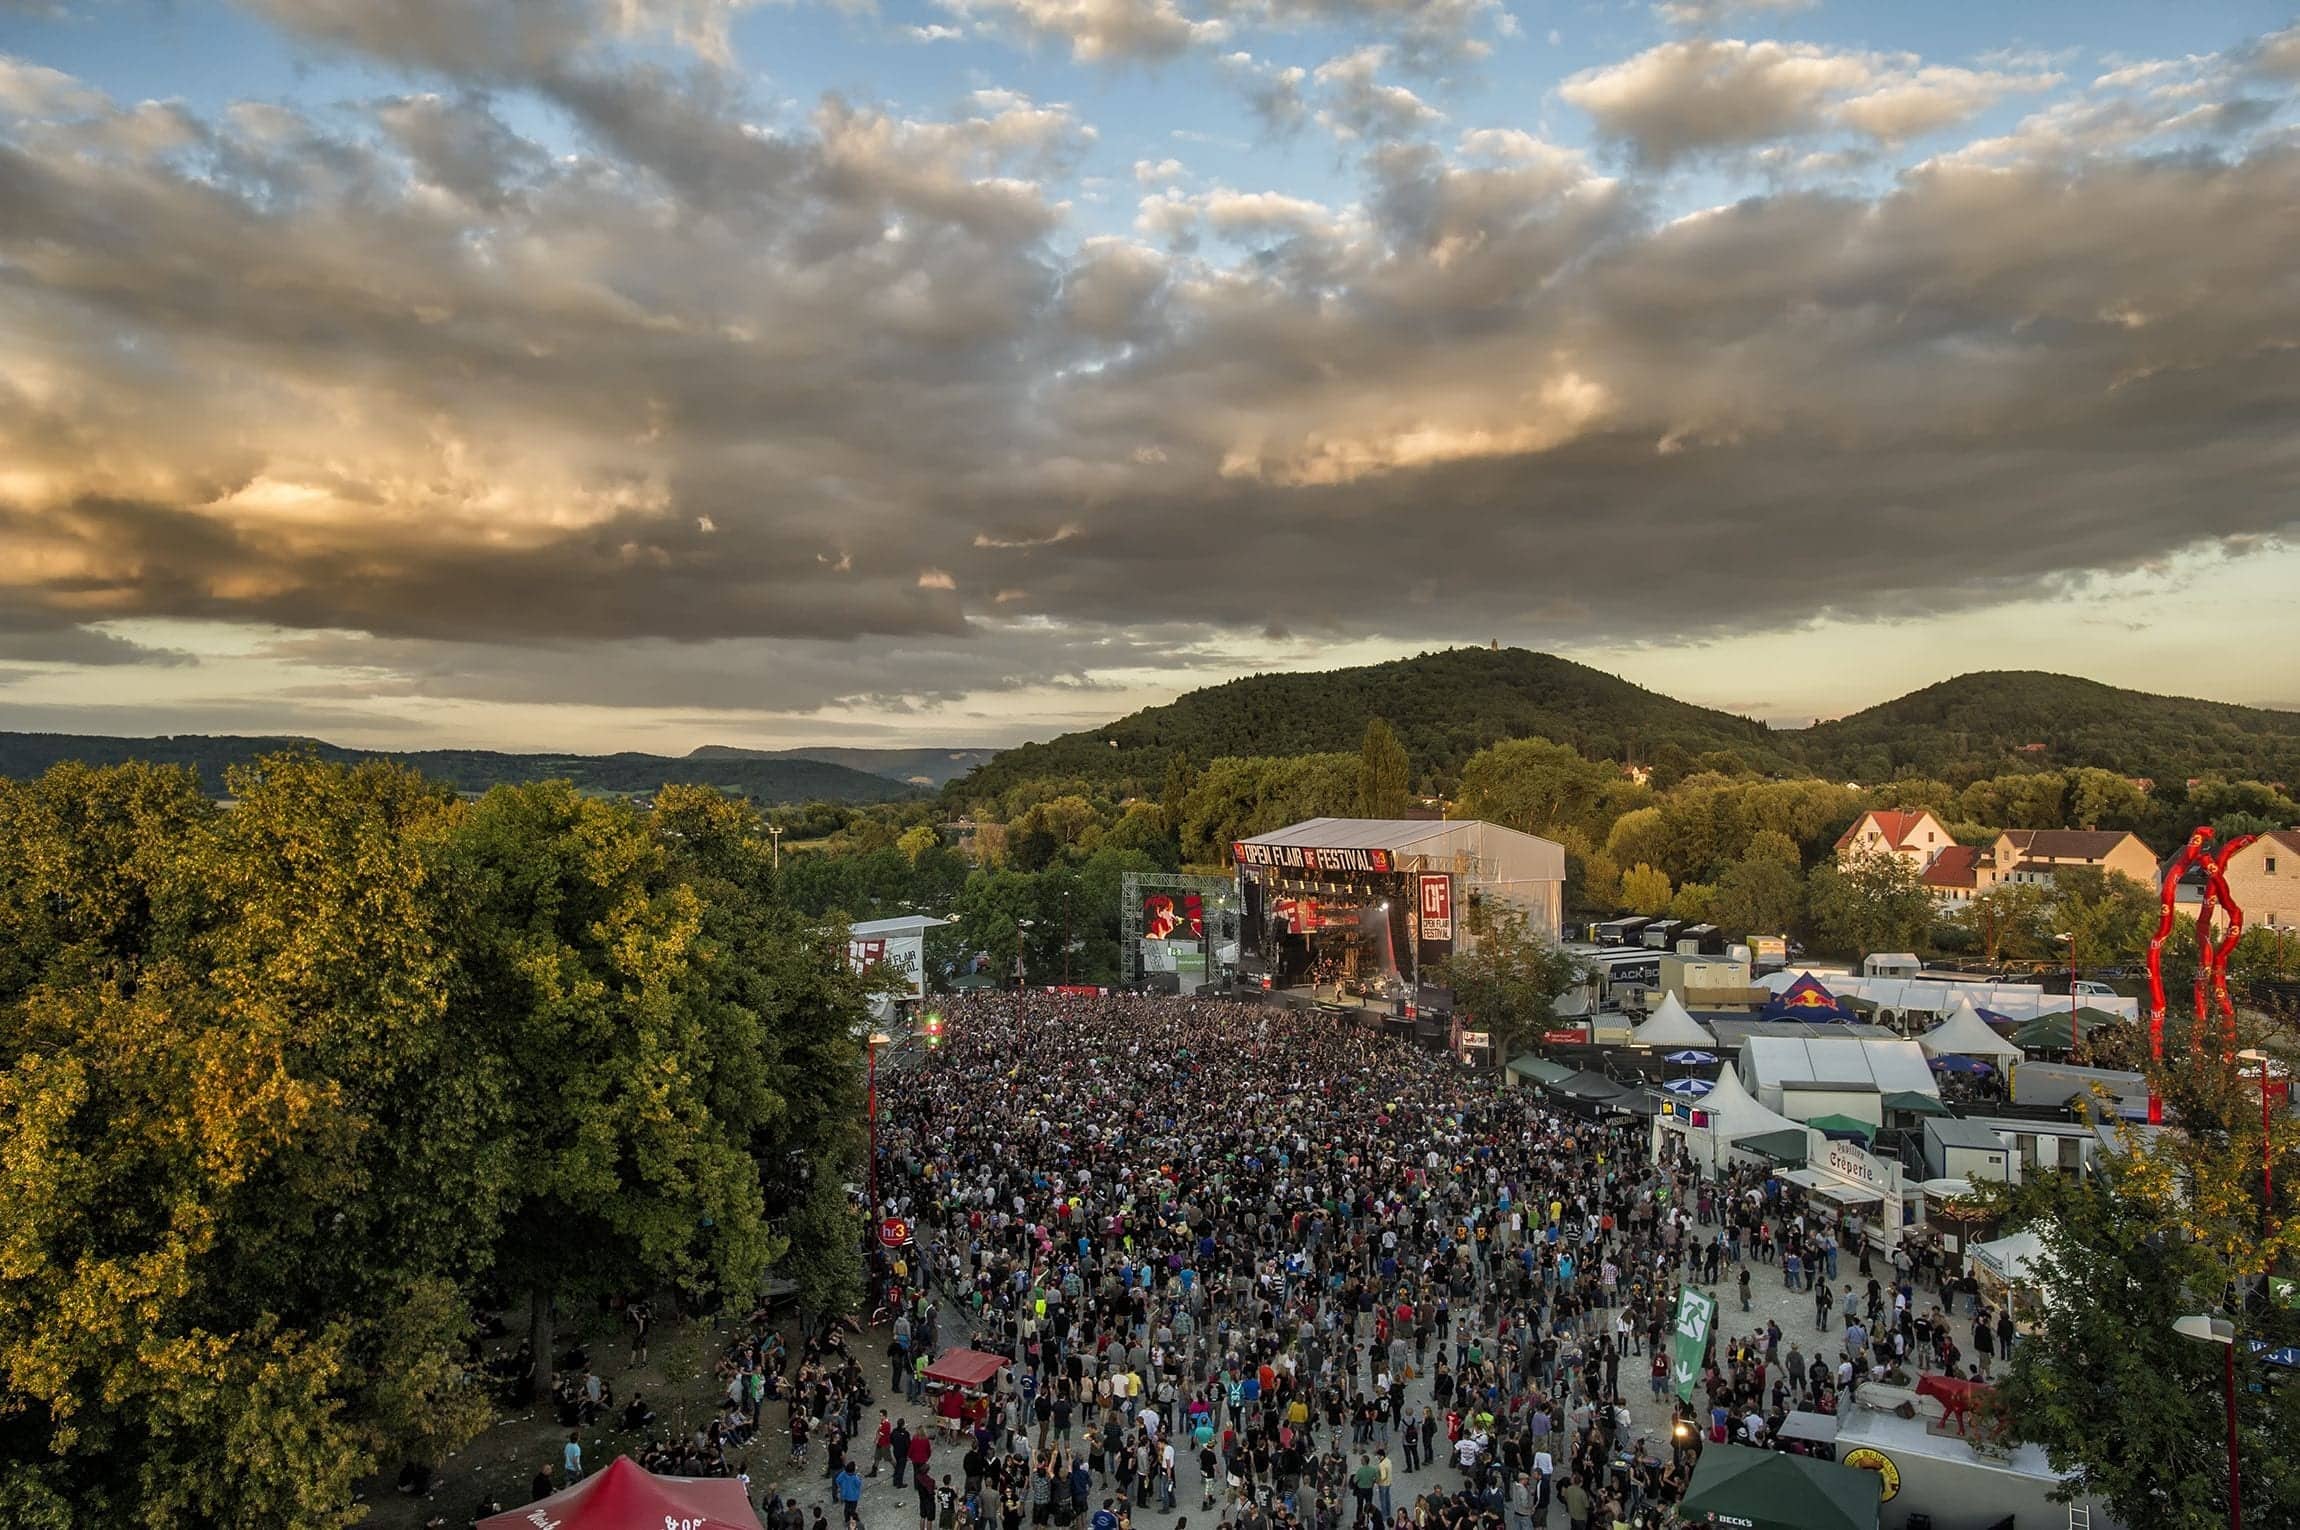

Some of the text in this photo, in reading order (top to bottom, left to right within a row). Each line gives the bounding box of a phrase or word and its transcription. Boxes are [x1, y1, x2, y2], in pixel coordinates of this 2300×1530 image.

[1244, 844, 1273, 865] OPEN
[1272, 846, 1304, 868] FLAIR
[1316, 848, 1374, 871] FESTIVAL
[1425, 884, 1445, 914] OF
[1423, 919, 1449, 928] OPEN FLAIR
[1423, 929, 1450, 939] FESTIVAL
[892, 950, 917, 964] FLAIR
[883, 1224, 905, 1237] hr3
